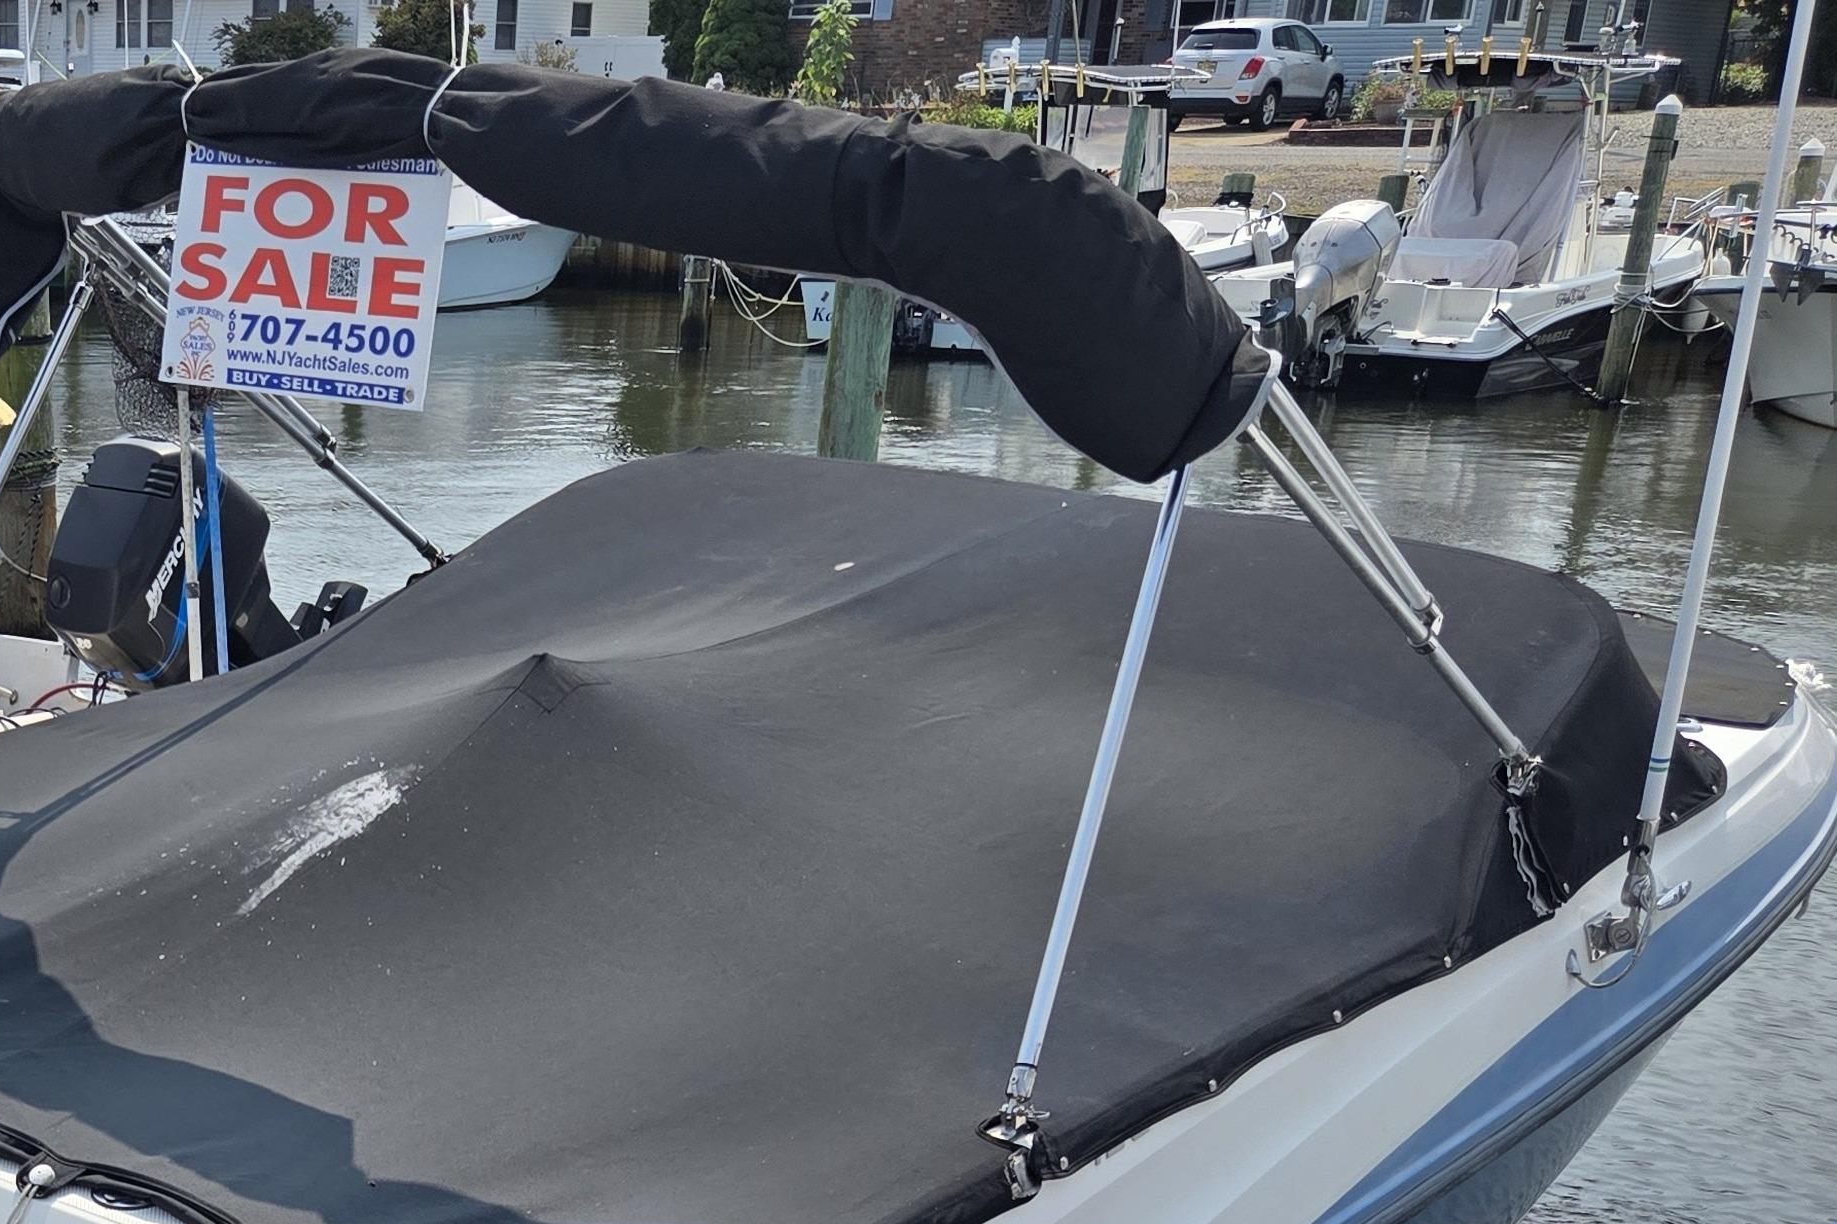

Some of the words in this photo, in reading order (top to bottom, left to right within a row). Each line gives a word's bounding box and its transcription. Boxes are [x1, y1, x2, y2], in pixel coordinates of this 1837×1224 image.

[196, 145, 214, 162] Do
[201, 175, 410, 247] FOR
[175, 242, 426, 319] SALE
[176, 306, 195, 319] NEW
[197, 306, 225, 322] JERSEY
[183, 341, 213, 352] SALES
[240, 313, 415, 358] 707-4500
[226, 349, 409, 379] www.NJYachtSales.com
[232, 370, 270, 385] BUY
[280, 377, 323, 393] SELL
[334, 382, 399, 401] TRADE
[145, 487, 204, 624] MERCY
